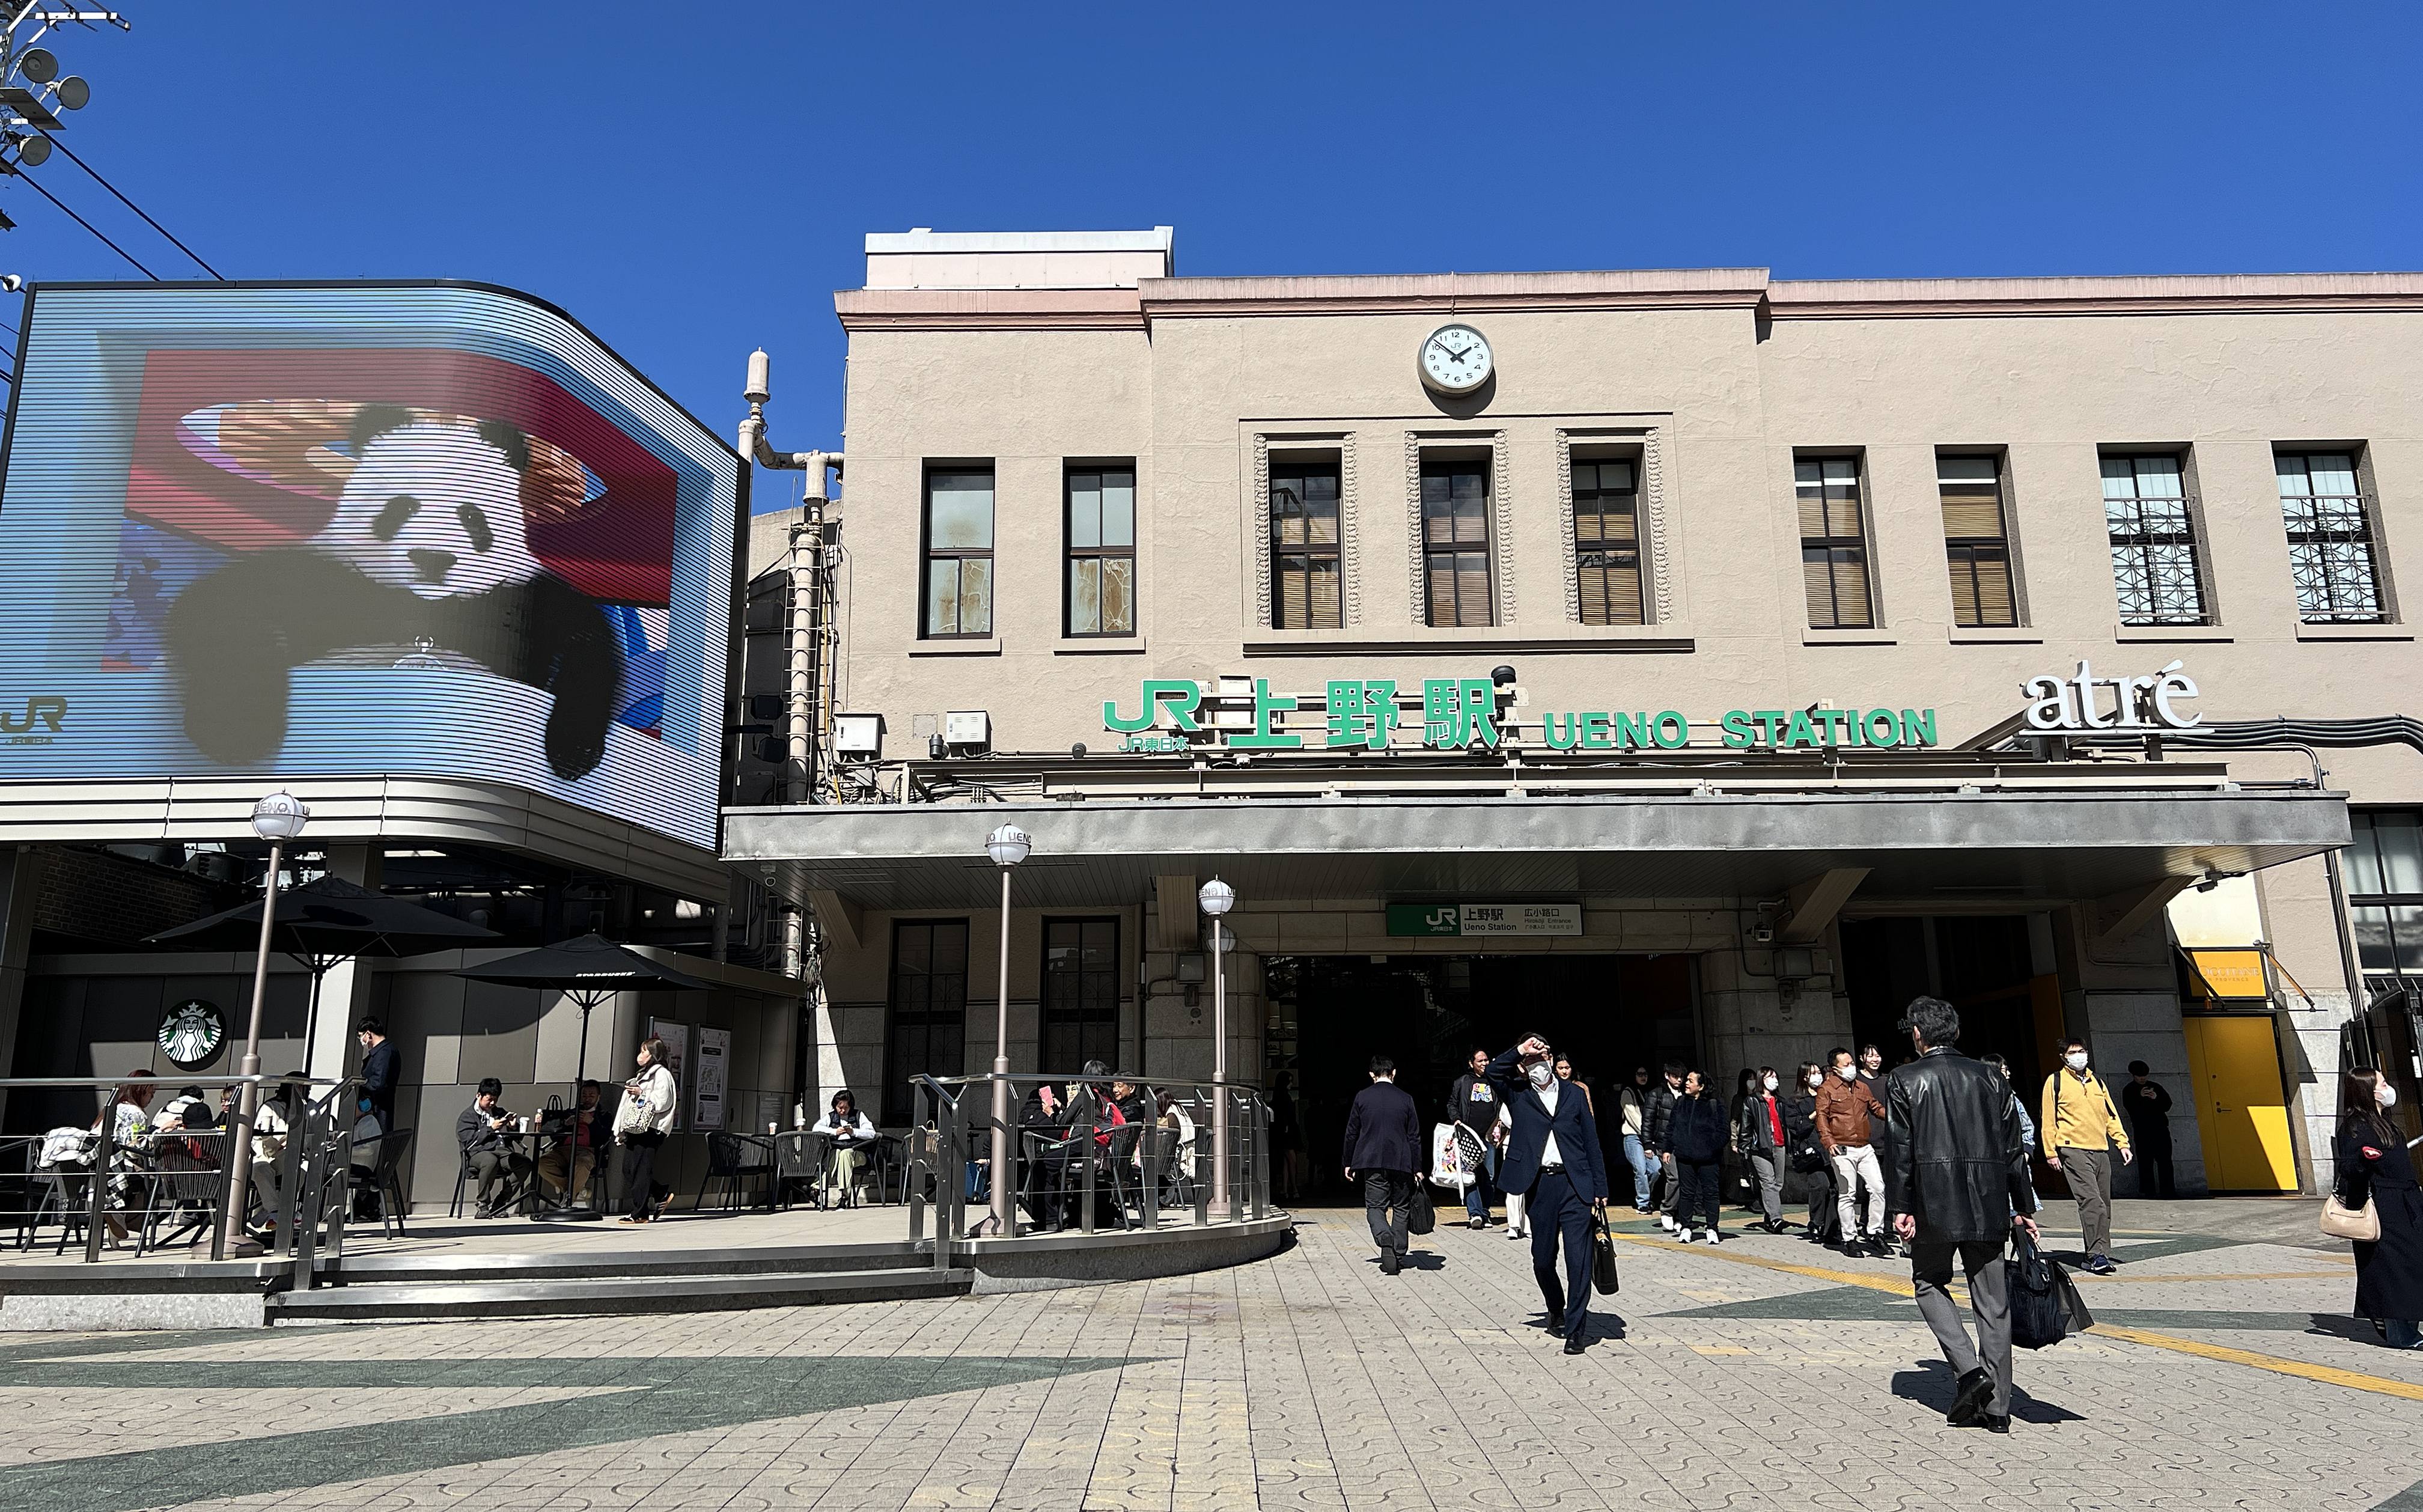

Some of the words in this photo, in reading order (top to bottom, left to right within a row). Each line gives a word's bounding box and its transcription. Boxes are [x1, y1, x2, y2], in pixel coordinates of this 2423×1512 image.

[2022, 659, 2202, 729] atré
[1103, 679, 1201, 732] JR
[1228, 678, 1499, 749] 上野駅
[1, 697, 67, 733] JR
[1543, 710, 1689, 750] UENO
[1721, 708, 1937, 749] STATION
[1118, 736, 1189, 752] JR東日本
[255, 802, 288, 813] UENO
[1009, 832, 1031, 843] UENO
[1426, 908, 1457, 925] JR
[1464, 908, 1504, 921] 上野駅
[2199, 965, 2260, 977] OCCITANE
